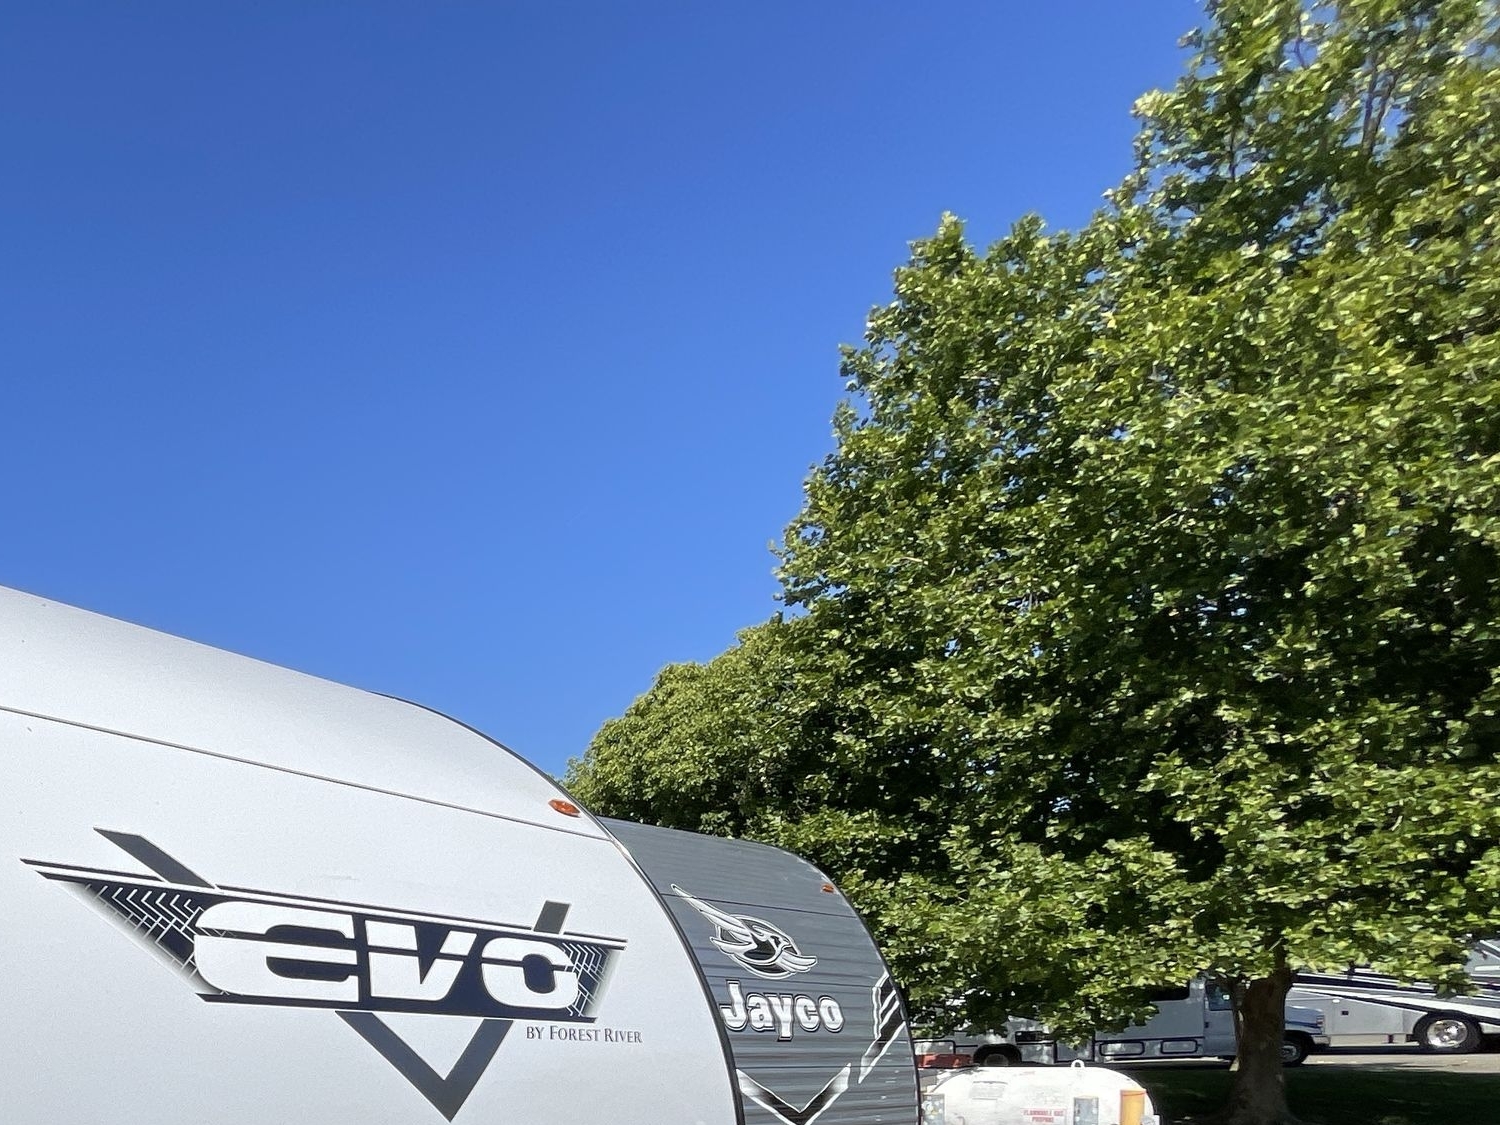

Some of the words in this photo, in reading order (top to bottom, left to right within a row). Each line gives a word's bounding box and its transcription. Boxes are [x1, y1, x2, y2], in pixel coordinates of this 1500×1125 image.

[719, 979, 844, 1042] Jayco
[526, 1026, 544, 1040] BY
[549, 1025, 600, 1041] FOREST
[604, 1028, 643, 1043] RIVER
